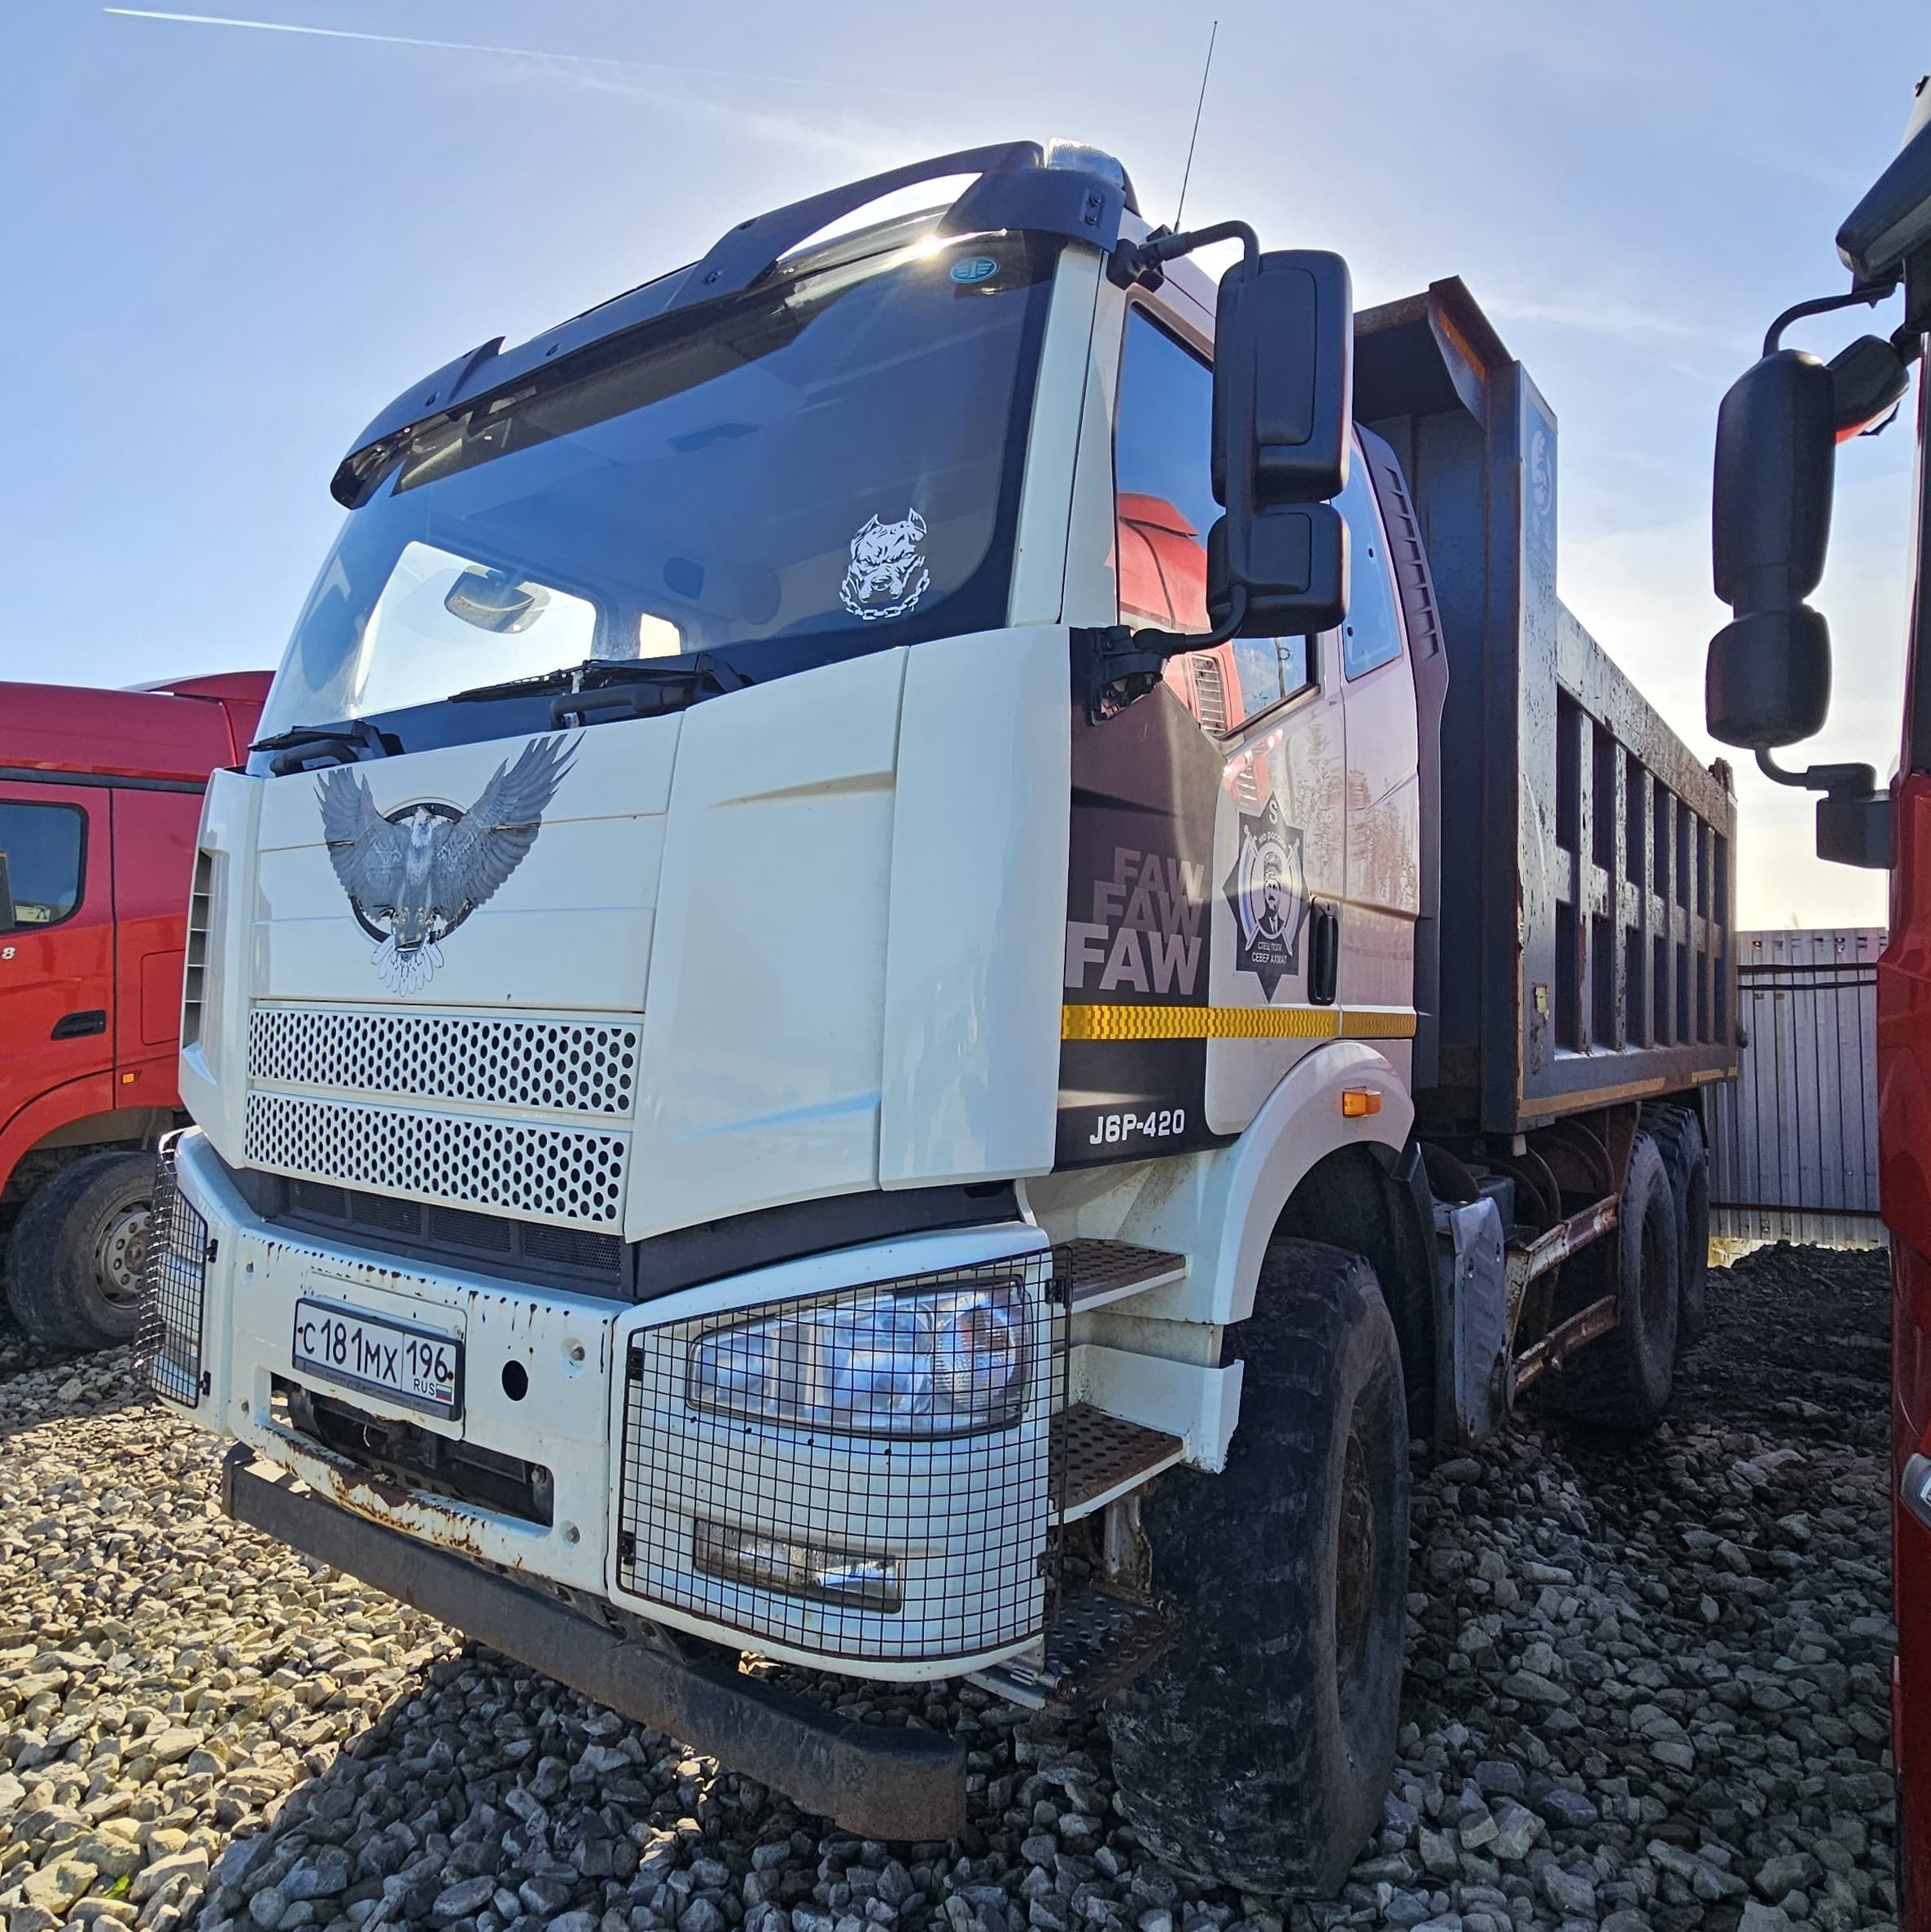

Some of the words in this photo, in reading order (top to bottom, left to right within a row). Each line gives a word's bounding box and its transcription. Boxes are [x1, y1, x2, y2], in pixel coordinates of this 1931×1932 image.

[1114, 847, 1204, 907] FAW
[1092, 880, 1204, 946] FAW
[1065, 921, 1202, 995] FAW
[1089, 1109, 1185, 1145] J6P-420
[414, 1378, 436, 1395] RUS
